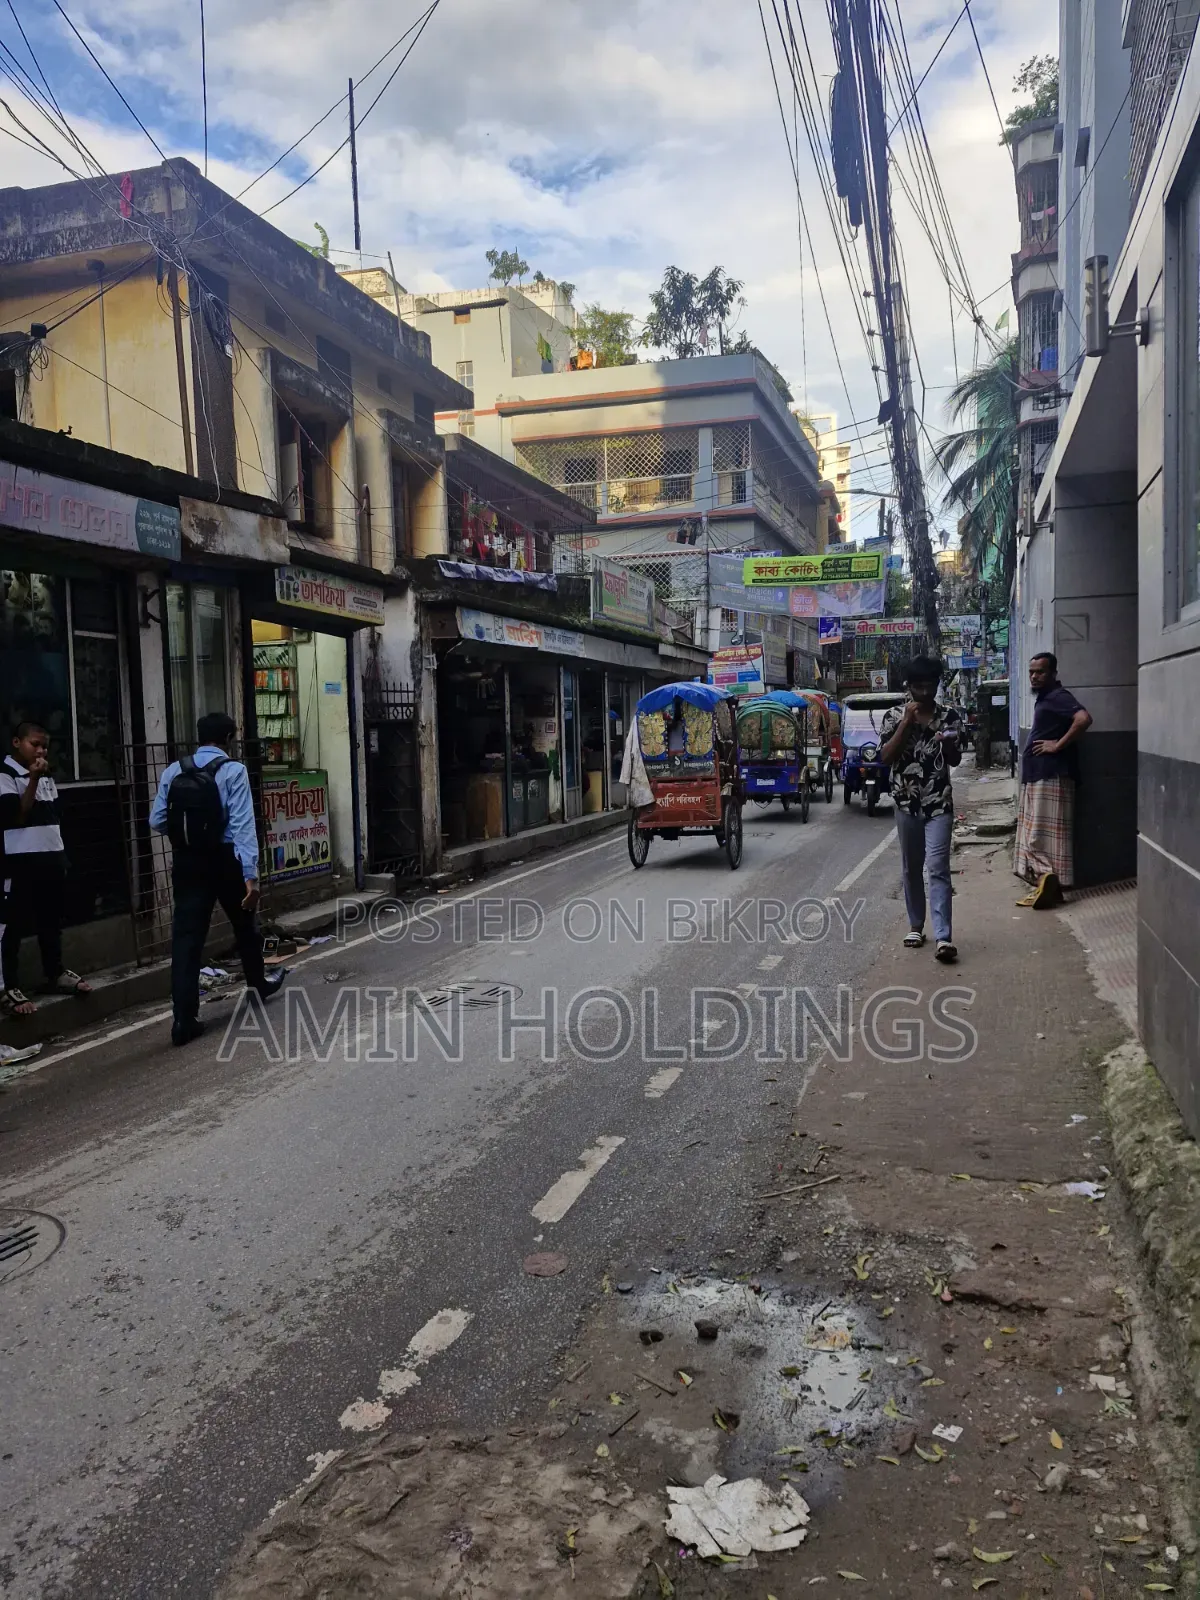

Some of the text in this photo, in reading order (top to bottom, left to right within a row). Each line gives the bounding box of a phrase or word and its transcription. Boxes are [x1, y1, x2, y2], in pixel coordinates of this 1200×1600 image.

[753, 565, 781, 577] কাব্য
[785, 561, 819, 576] কোচিং
[301, 579, 346, 612] তাশফিয়া
[857, 620, 876, 634] গ্রীন
[880, 619, 915, 633] গার্ডেন
[262, 780, 326, 820] তাশফিয়া
[288, 826, 309, 842] মোবাইল
